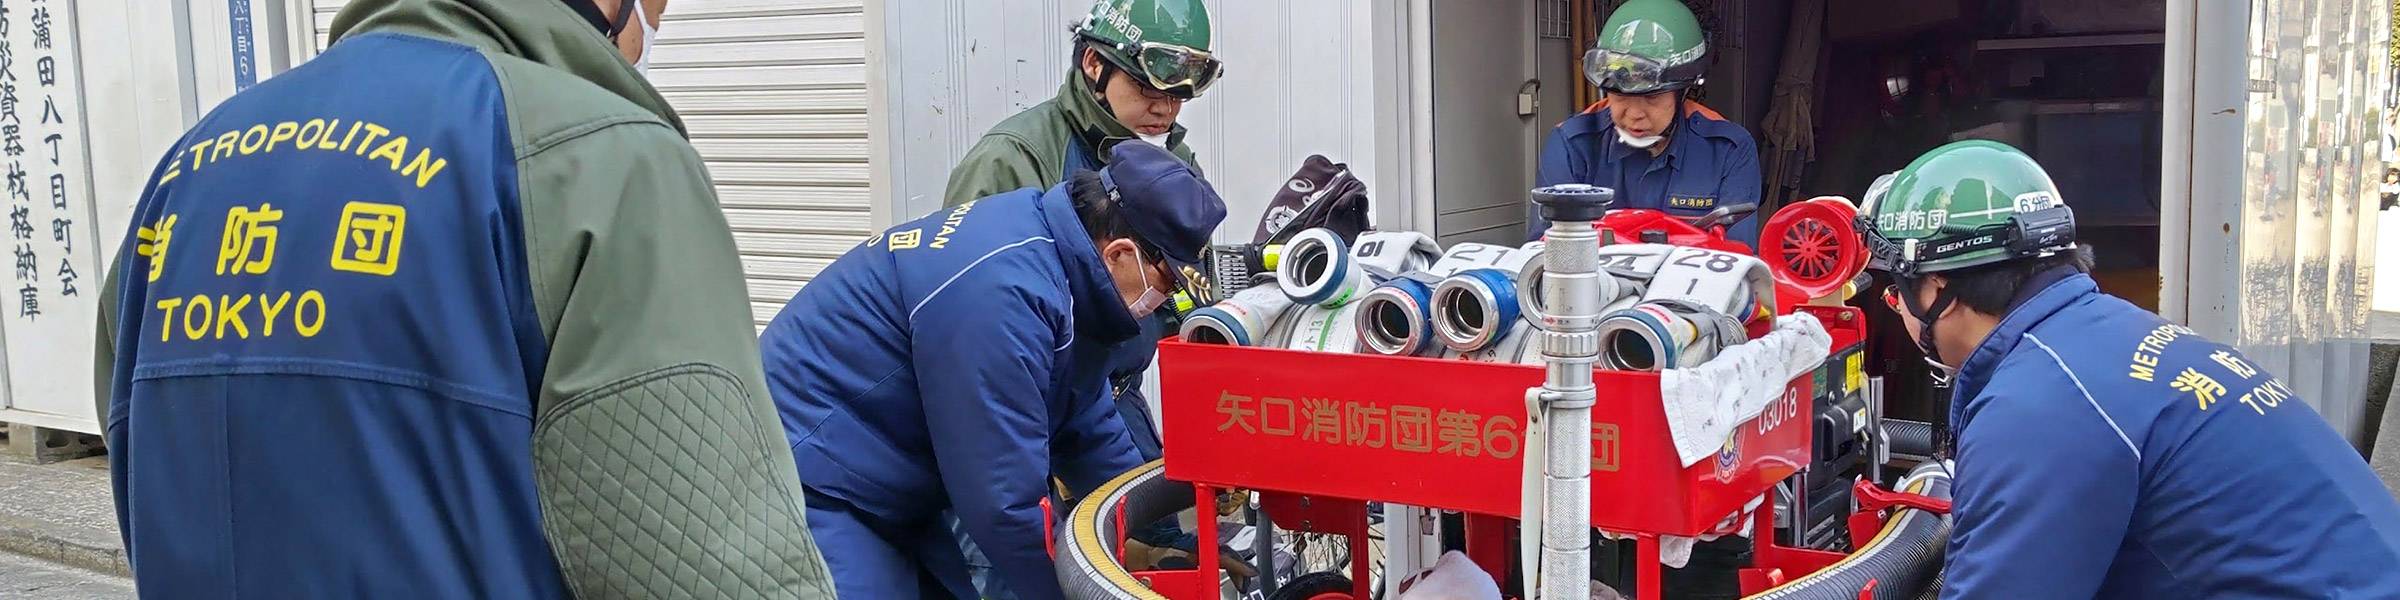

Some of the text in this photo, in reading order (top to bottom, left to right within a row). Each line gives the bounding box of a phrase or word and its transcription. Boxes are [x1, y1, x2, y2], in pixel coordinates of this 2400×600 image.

[29, 0, 78, 298] 蒲田八丁目町会
[158, 118, 447, 188] ETROPOLITAN
[1671, 197, 1713, 207] 矢口消防団
[1673, 249, 1739, 273] 28
[1936, 234, 1993, 254] GENTOS
[156, 289, 326, 342] TOKYO
[1216, 390, 1621, 472] 矢口消防団第6団
